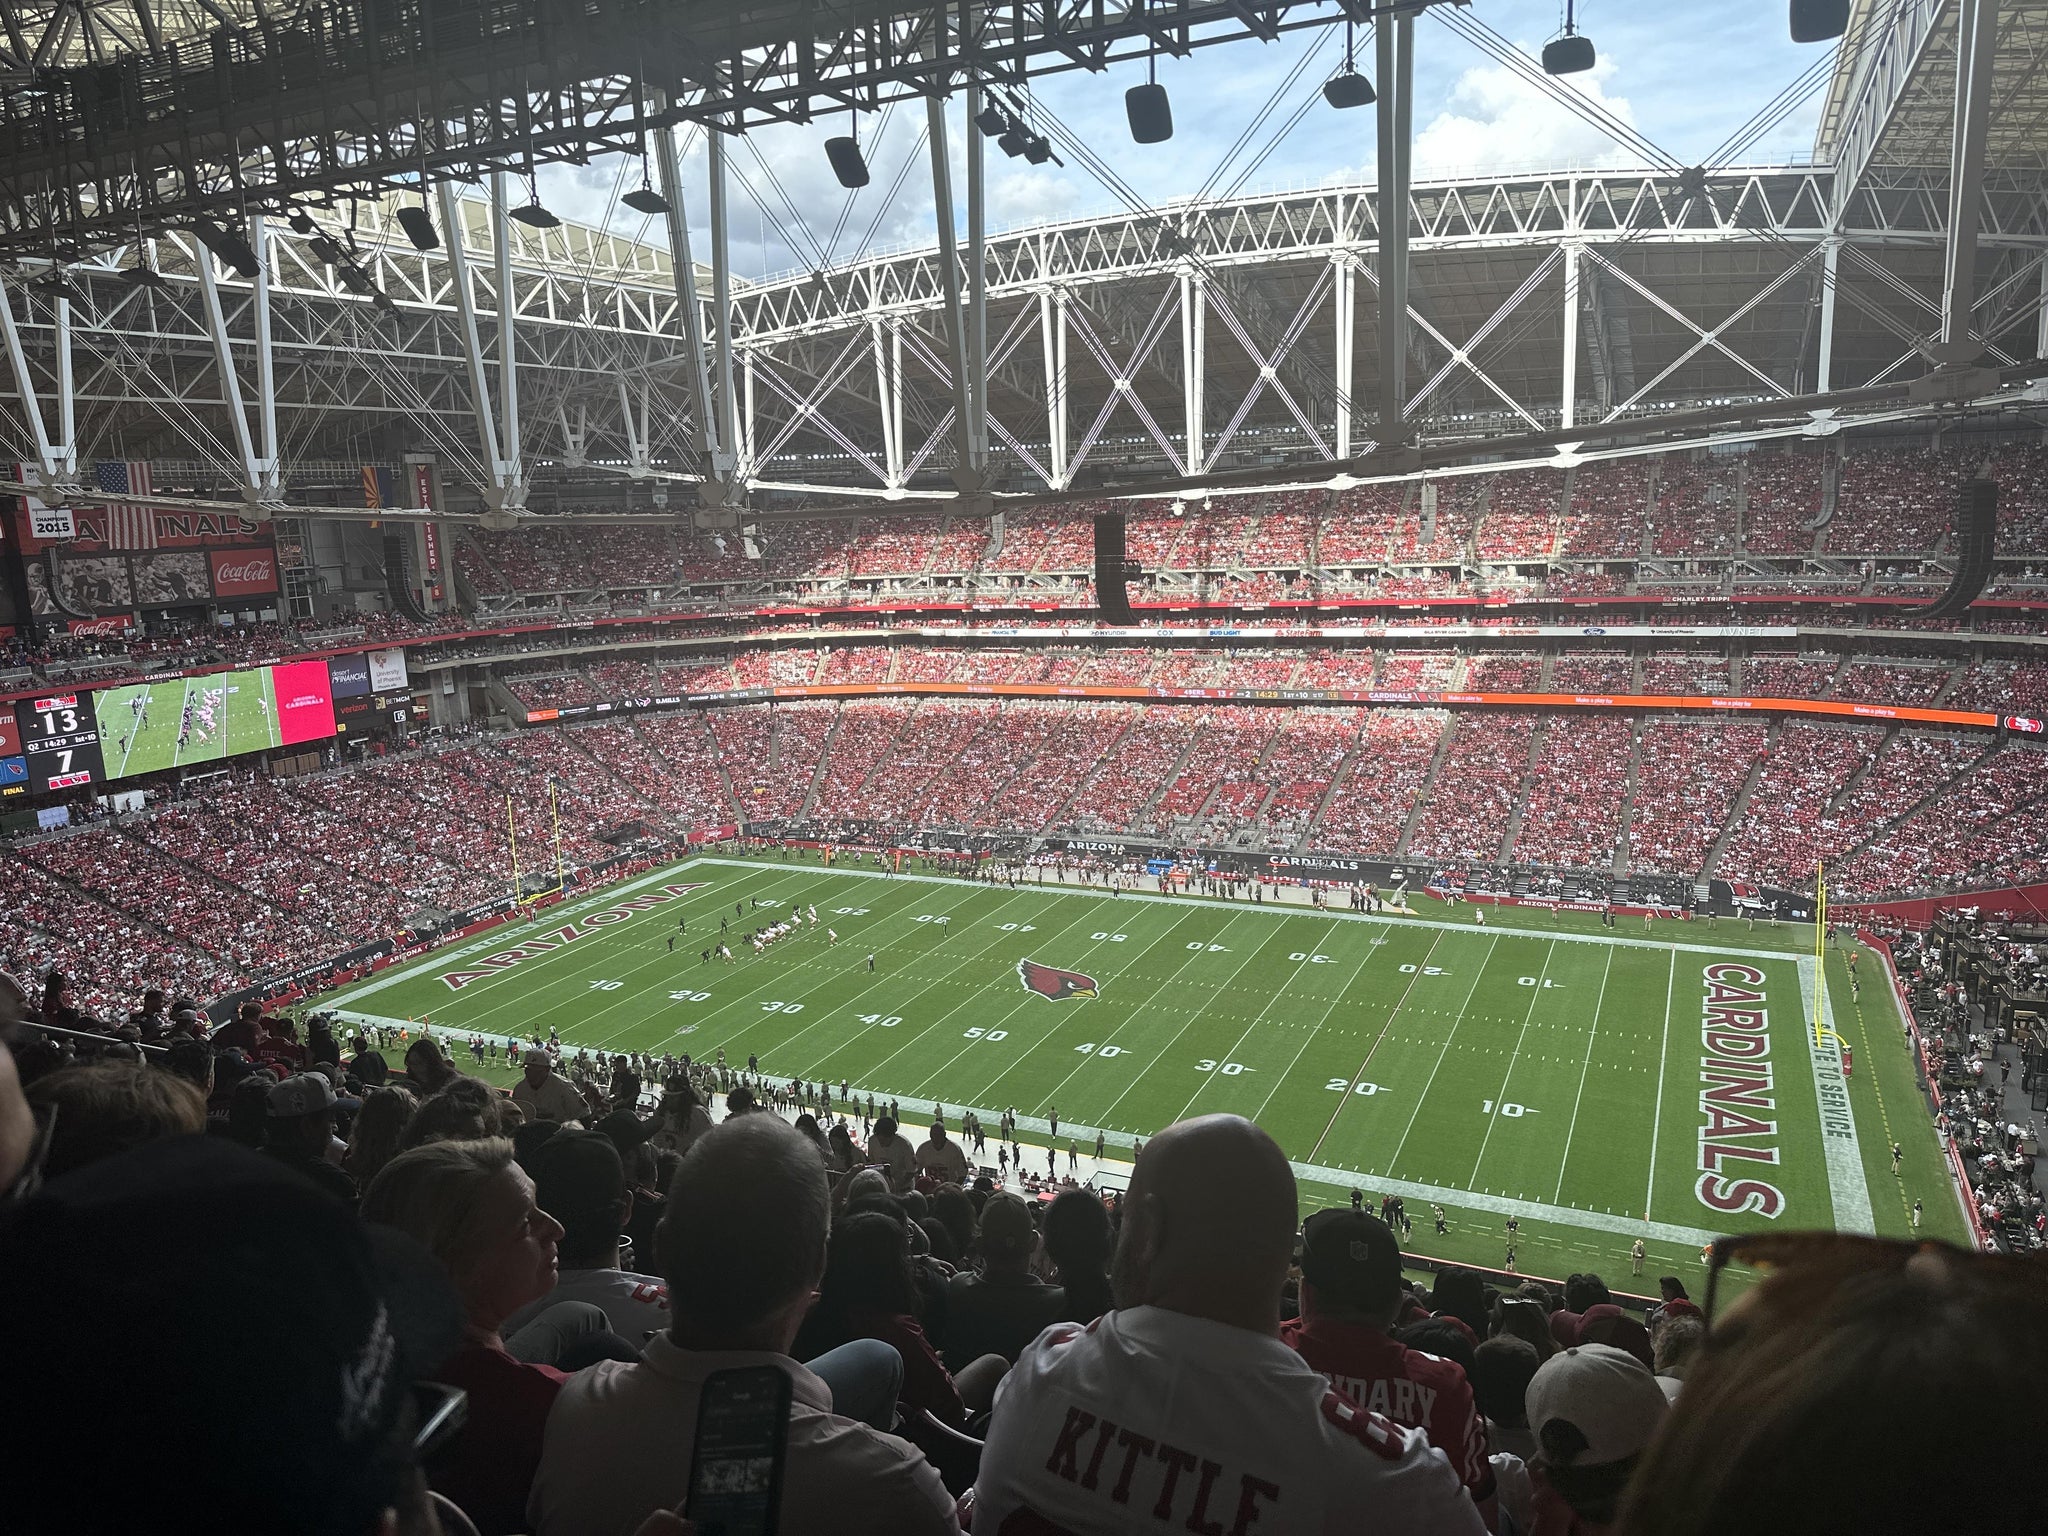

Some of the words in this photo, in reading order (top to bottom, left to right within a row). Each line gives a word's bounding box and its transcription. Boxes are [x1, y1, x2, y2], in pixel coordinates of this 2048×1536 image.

[37, 522, 70, 533] 2015
[420, 479, 436, 565] ESTAISHED
[217, 560, 271, 584] Coca-Cola
[1718, 628, 1764, 636] AVNET
[145, 671, 183, 681] CARDINALS
[386, 696, 410, 705] BETMGM
[341, 704, 368, 714] verizon
[44, 710, 78, 734] 13
[28, 742, 40, 751] Q2
[45, 738, 66, 748] 14:29
[57, 750, 73, 774] 7
[3, 786, 24, 796] FINAL
[836, 907, 870, 916] 20
[1517, 900, 1553, 908] ARIZONA
[1557, 903, 1604, 912] CARDINALS
[1000, 923, 1037, 932] 40
[432, 881, 714, 992] ARIZONA
[1090, 932, 1128, 942] 50
[1186, 942, 1225, 952] 40
[389, 947, 422, 963] ARIONA
[1288, 952, 1330, 964] 30
[296, 962, 333, 978] CARDINALS
[1398, 964, 1443, 976] 20
[590, 980, 624, 991] 10
[1518, 976, 1553, 988] 10
[670, 991, 712, 1002] 20
[762, 1002, 805, 1014] 30
[860, 1014, 904, 1028] 40
[963, 1027, 1008, 1042] 50
[1074, 1043, 1121, 1058] 40
[1194, 1059, 1244, 1076] 30
[1817, 1066, 1840, 1080] TO
[1324, 1078, 1378, 1096] 20
[1694, 963, 1786, 1220] CARDINALS
[1482, 1100, 1526, 1118] 10
[1820, 1084, 1852, 1140] SERVICE
